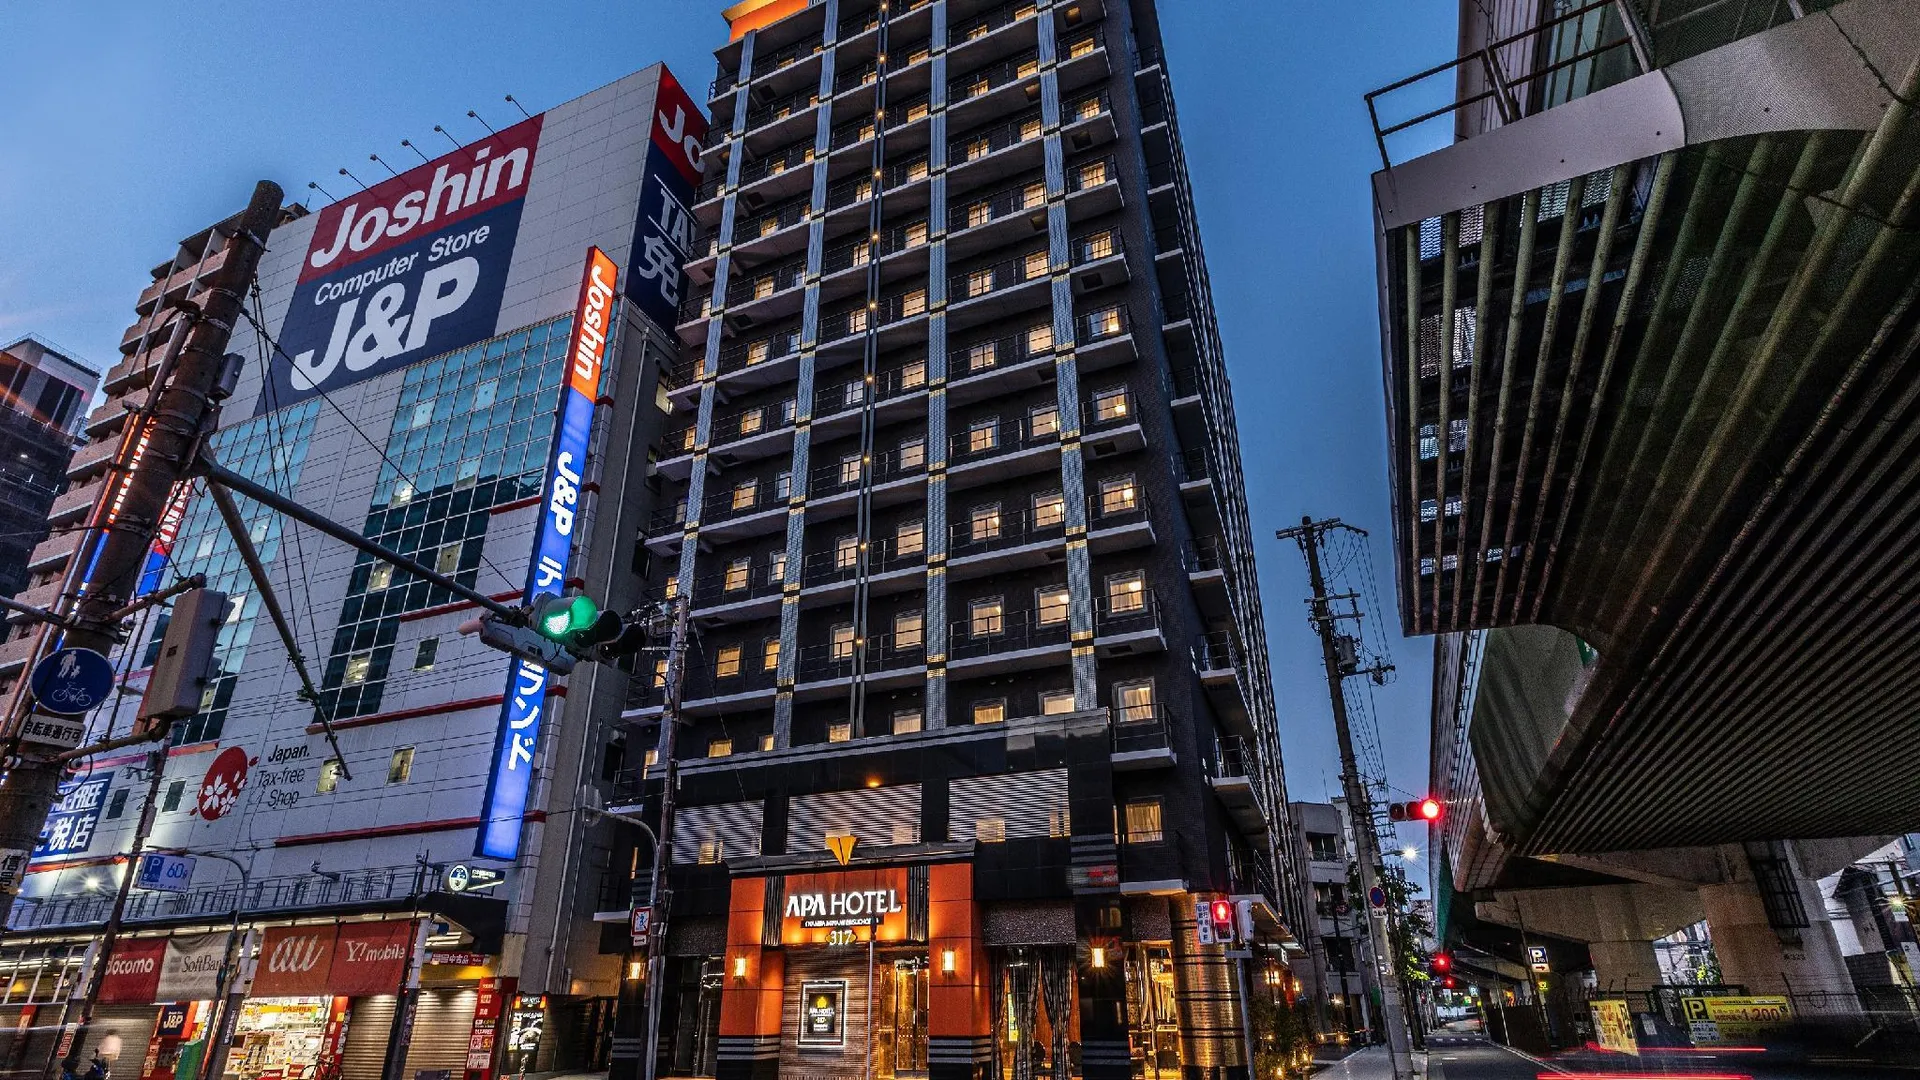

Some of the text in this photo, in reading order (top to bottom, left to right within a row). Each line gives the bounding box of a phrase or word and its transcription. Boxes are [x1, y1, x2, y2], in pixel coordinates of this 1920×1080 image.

[658, 104, 706, 173] Jo
[310, 146, 529, 267] Joshin
[314, 224, 491, 306] Computer Store
[638, 234, 681, 308] 免
[290, 256, 480, 391] J&P
[575, 264, 612, 381] Joshin
[550, 451, 580, 536] J&P
[23, 720, 83, 743] 自転車通行可
[258, 768, 305, 787] Tax-free
[268, 788, 300, 811] Shop
[150, 857, 161, 872] P
[785, 889, 902, 917] APA HOTEL
[829, 929, 853, 946] 317
[181, 954, 223, 973] SoftBan
[269, 933, 324, 973] au
[1531, 949, 1543, 962] P
[163, 1014, 184, 1029] J&P
[1688, 1000, 1704, 1019] P
